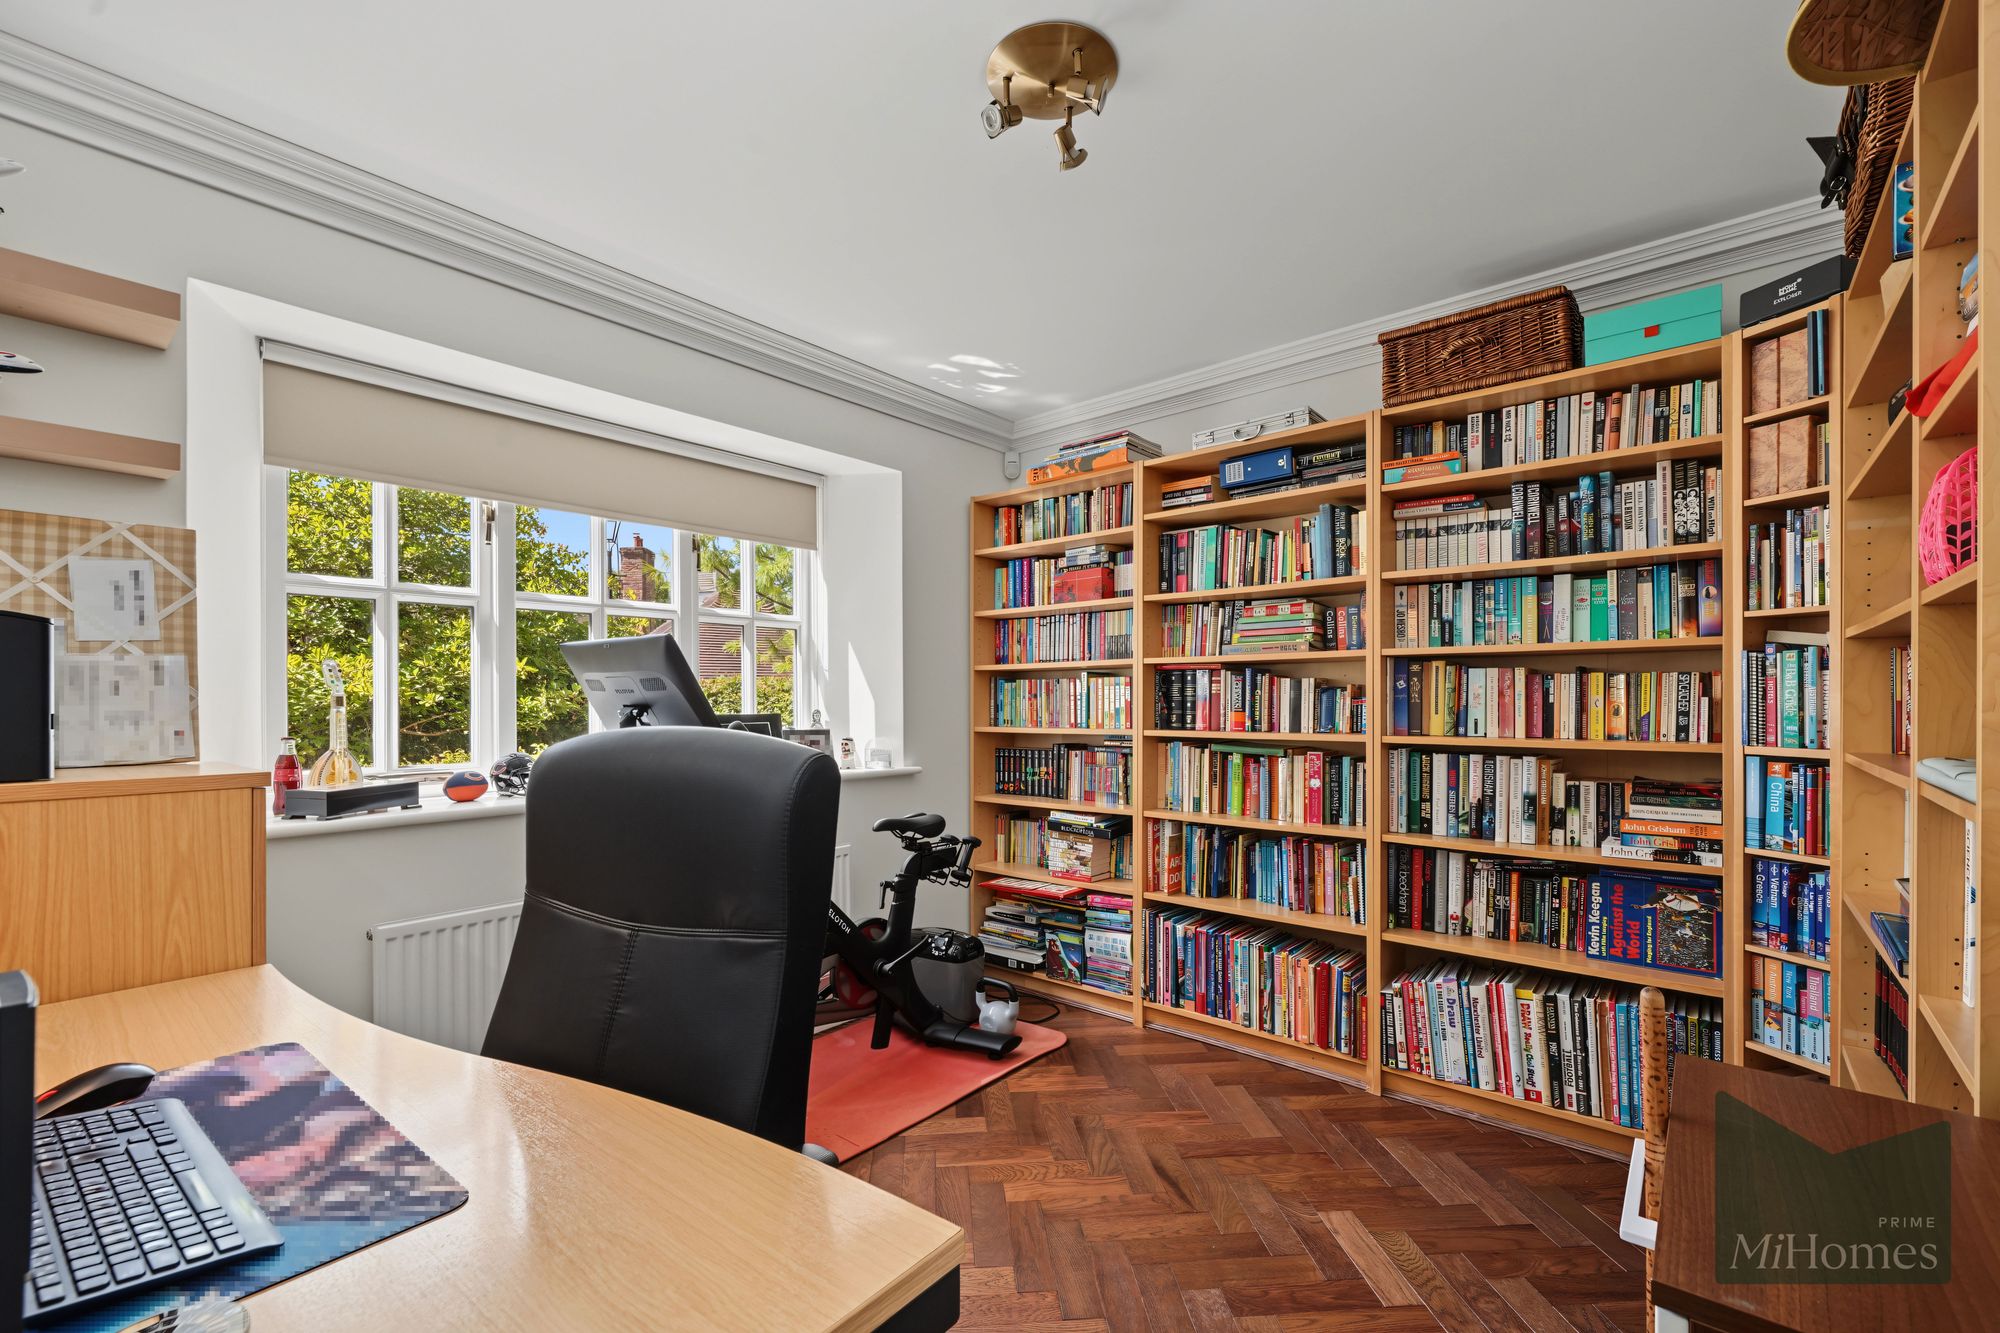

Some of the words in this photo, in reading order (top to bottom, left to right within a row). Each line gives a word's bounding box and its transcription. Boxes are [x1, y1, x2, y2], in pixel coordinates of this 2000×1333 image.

[1773, 290, 1802, 305] EXPLORER
[1512, 487, 1524, 524] CORNWELL
[1528, 487, 1540, 526] CORNWELL
[1624, 491, 1632, 506] BILL
[1707, 496, 1715, 512] Will
[1624, 506, 1633, 530] BRYSON
[1706, 519, 1715, 538] High
[1326, 610, 1334, 639] Collins
[1338, 610, 1346, 639] Collins
[1396, 609, 1406, 618] JO
[1785, 668, 1796, 687] B&B
[1254, 689, 1262, 720] German
[1678, 674, 1690, 712] SPYCATCHER
[1784, 688, 1796, 716] Guide
[1421, 755, 1430, 772] JACK
[1472, 760, 1480, 774] John
[1421, 773, 1430, 799] HIGGINS
[1484, 764, 1494, 796] GRISHAM
[1448, 790, 1456, 813] STEPHEN
[1770, 782, 1782, 813] China
[1448, 814, 1456, 826] KING
[1624, 822, 1645, 832] John
[1647, 823, 1686, 835] Grisham
[1609, 846, 1633, 857] John
[1635, 848, 1679, 862] Grisham
[1629, 836, 1651, 846] John
[1653, 838, 1694, 850] Grisham
[1398, 871, 1410, 913] beckham
[1552, 876, 1560, 895] Crew
[1610, 884, 1624, 905] the
[1755, 874, 1765, 904] Greece
[1770, 877, 1780, 908] Vietnam
[1588, 882, 1603, 924] Keegan
[828, 908, 851, 935] ELOTON
[1610, 908, 1626, 958] Against
[1588, 924, 1600, 955] Kevin
[1626, 920, 1641, 959] World
[1185, 968, 1193, 997] EGYPT
[1769, 972, 1777, 1000] Australia
[1785, 970, 1793, 983] New
[1785, 985, 1793, 999] York
[1809, 976, 1820, 1012] Thailand
[1446, 998, 1457, 1028] Draw
[1472, 997, 1482, 1035] Manchester
[1520, 1002, 1532, 1030] DRAW
[1475, 1036, 1484, 1058] United
[1524, 1032, 1532, 1053] Really
[1666, 1017, 1674, 1051] GUINNESS
[1677, 1020, 1686, 1054] GUINNESS
[1526, 1053, 1534, 1068] Cool
[1549, 1042, 1558, 1056] 1987
[1526, 1068, 1536, 1088] Stuff
[1565, 1050, 1574, 1088] FOOTBALL
